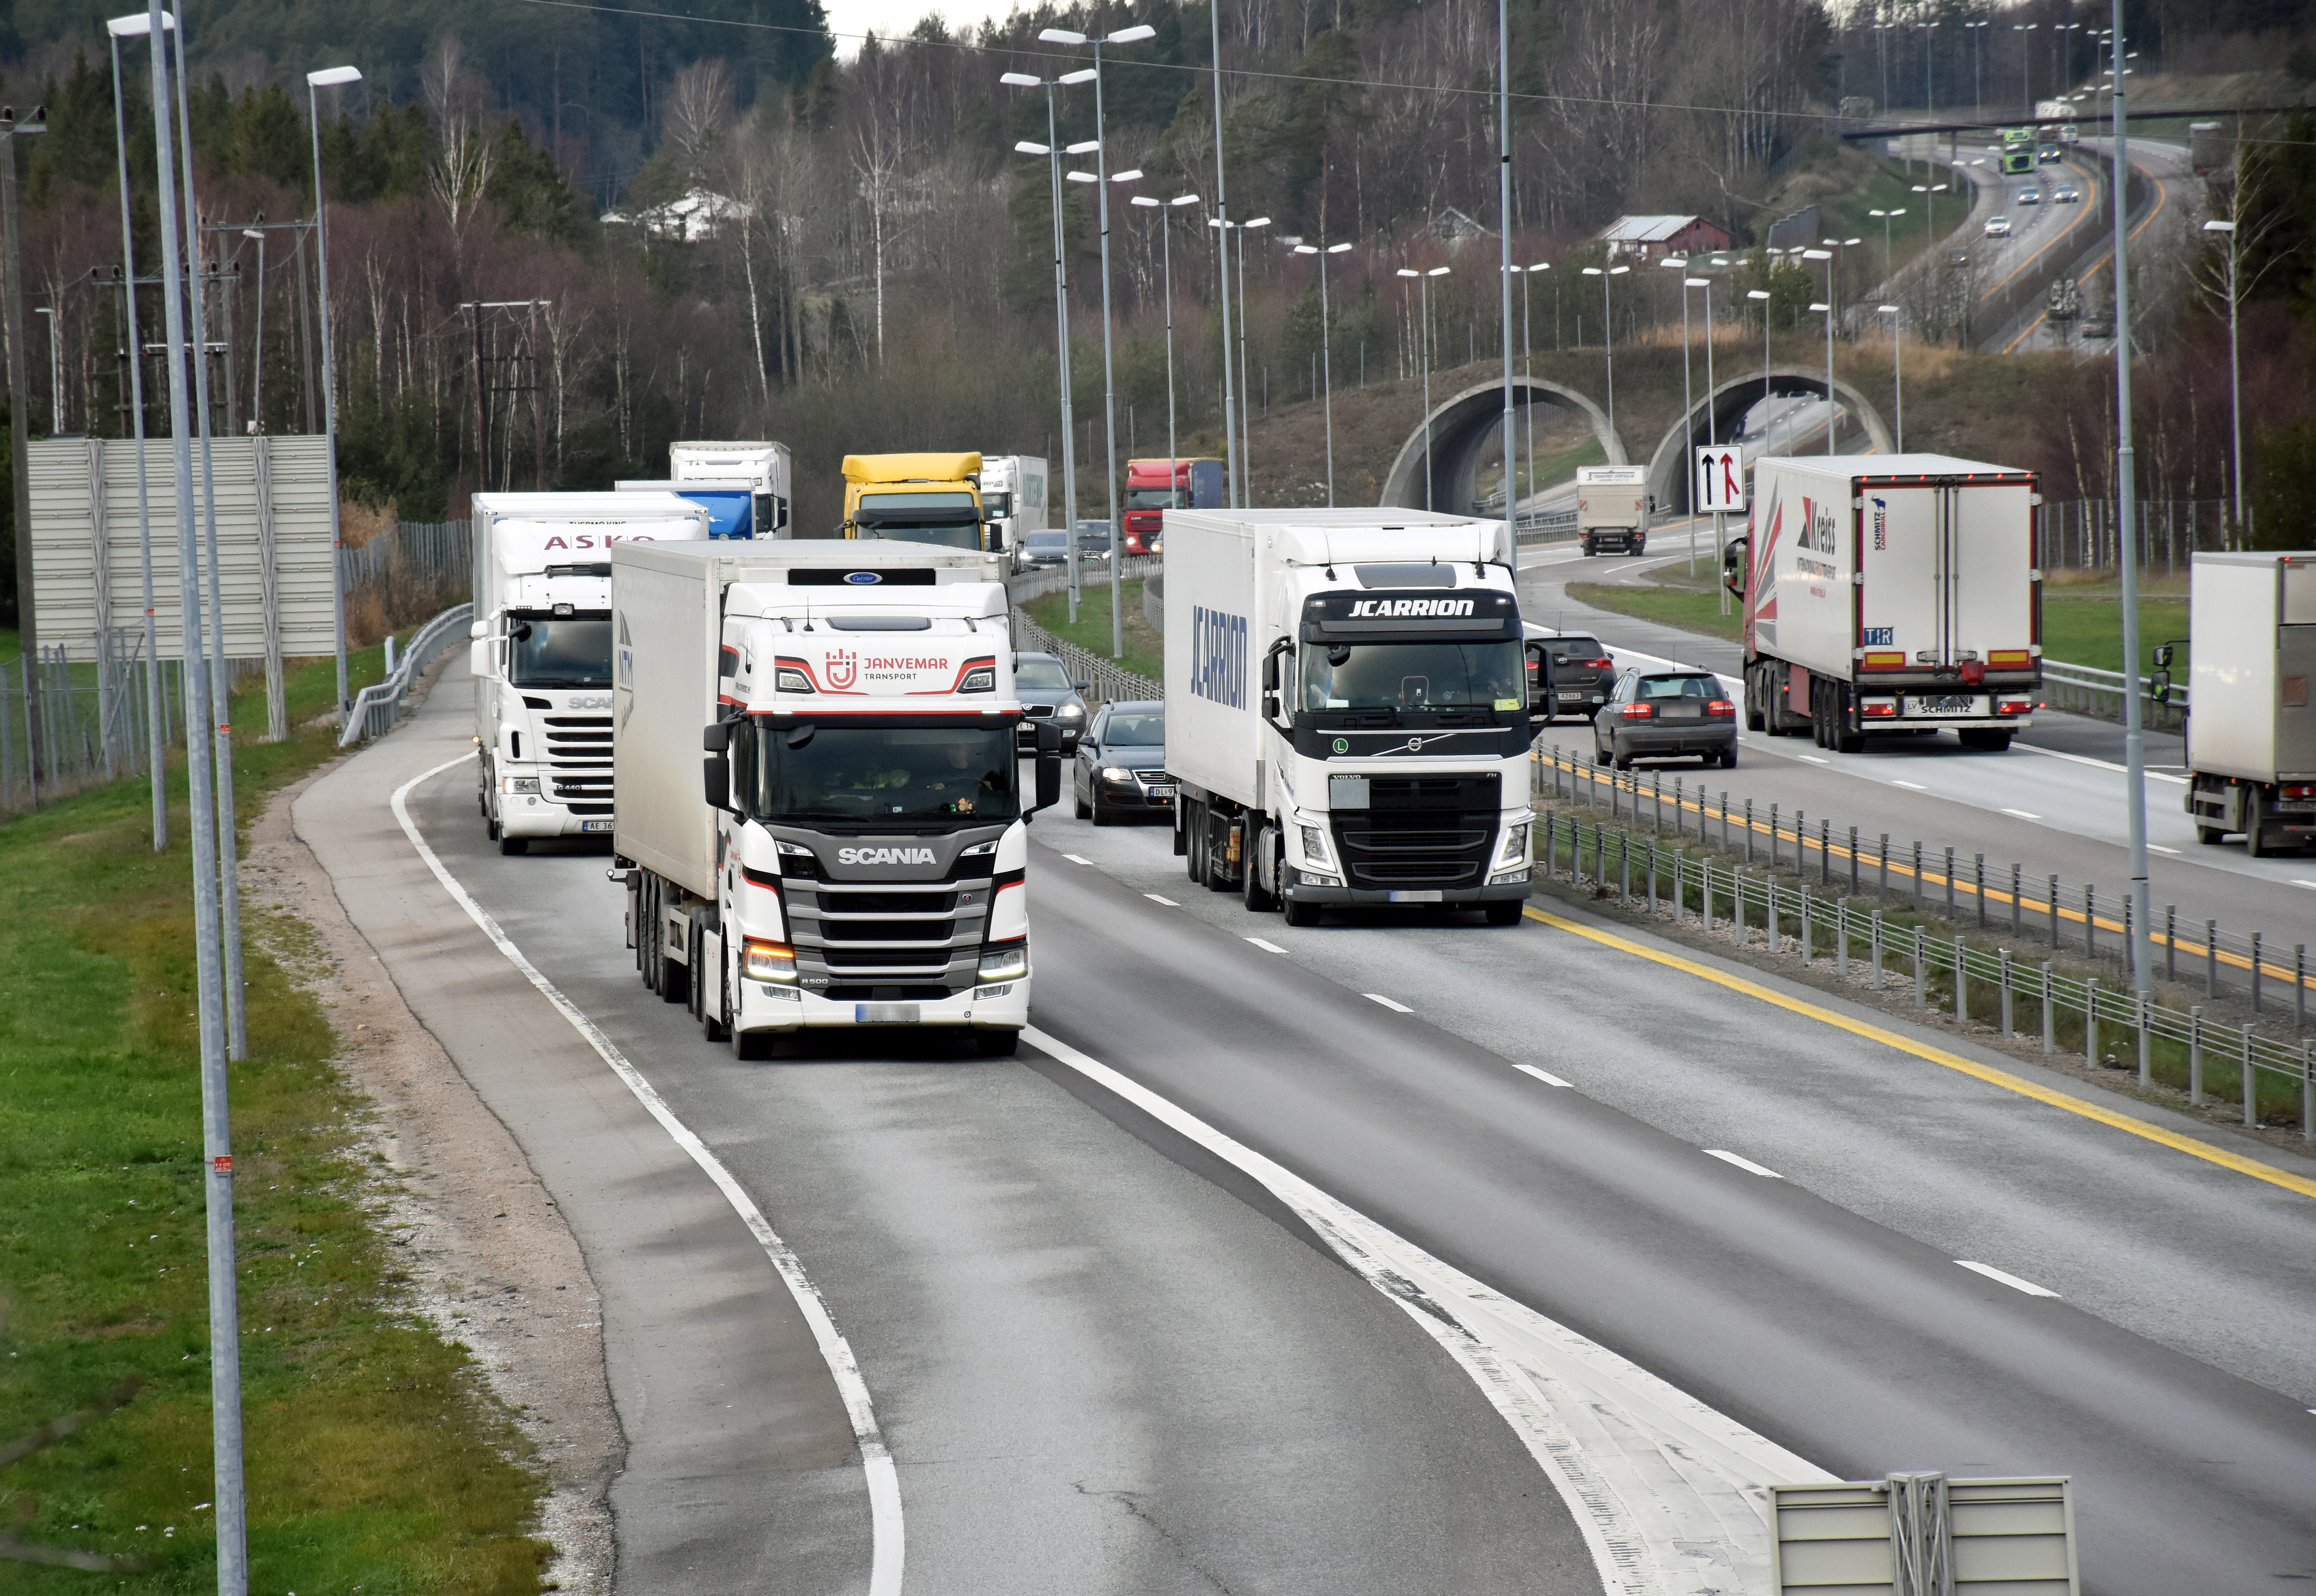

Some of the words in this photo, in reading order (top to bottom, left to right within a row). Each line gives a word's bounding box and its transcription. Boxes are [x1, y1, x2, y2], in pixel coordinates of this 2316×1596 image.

[1811, 501, 1835, 556] Kreiss
[1348, 600, 1474, 617] JCARRION
[1866, 629, 1891, 644] TIR
[864, 658, 949, 669] JANVEMAR
[1191, 605, 1247, 711] JCARRION
[619, 649, 633, 687] NTM
[1338, 741, 1344, 751] L
[838, 848, 937, 864] SCANIA
